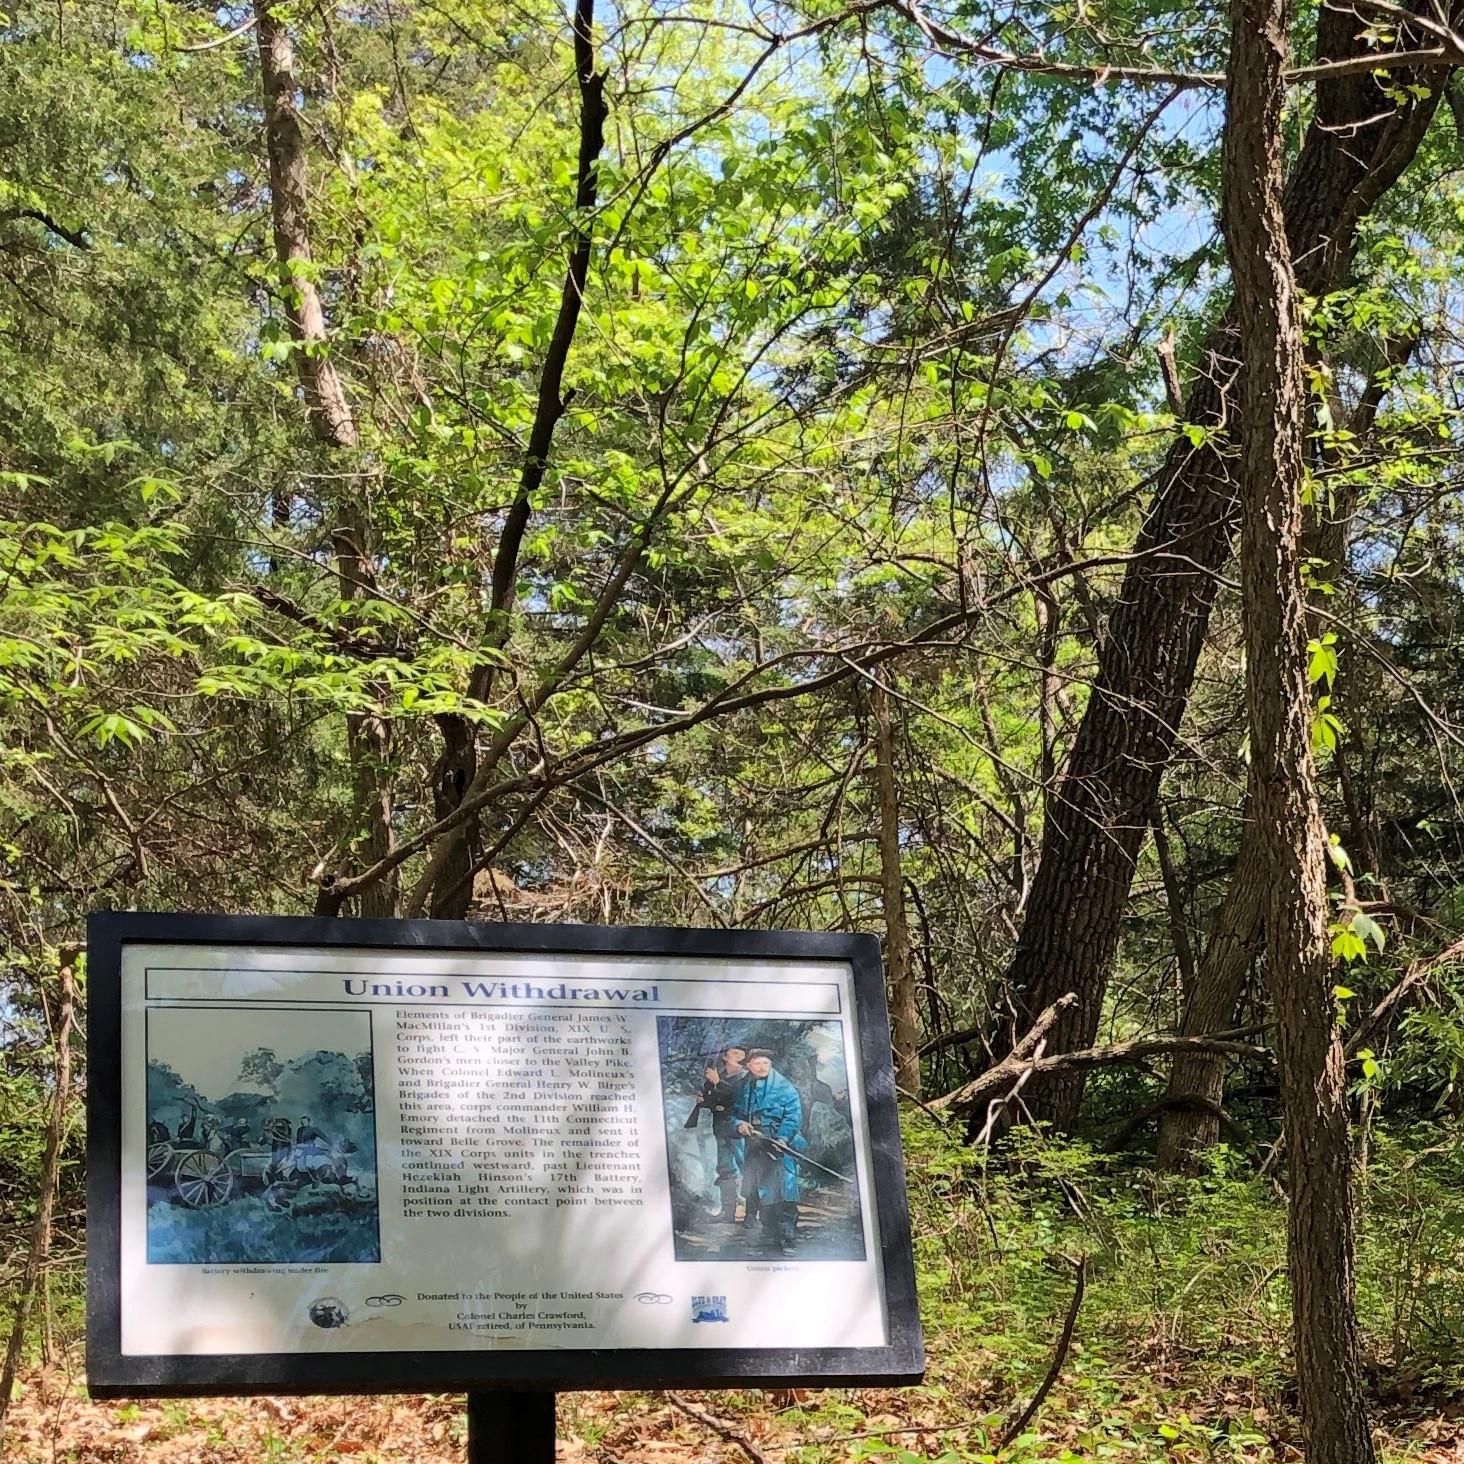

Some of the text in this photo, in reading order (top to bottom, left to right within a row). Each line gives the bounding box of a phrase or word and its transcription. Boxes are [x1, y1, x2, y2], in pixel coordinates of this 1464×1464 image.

[342, 978, 662, 1002] Union Withdrawal
[396, 1010, 450, 1019] Elements
[454, 1011, 465, 1020] of
[470, 1011, 524, 1023] Brigadier
[528, 1012, 572, 1021] General
[576, 1013, 612, 1023] James
[396, 1022, 470, 1031] MacMillan's
[480, 1023, 496, 1031] 1st
[506, 1023, 558, 1034] Division,
[568, 1024, 590, 1033] XIX
[440, 1033, 458, 1042] left
[464, 1034, 492, 1043] their
[498, 1034, 520, 1046] part
[526, 1035, 538, 1043] of
[542, 1035, 562, 1044] the
[566, 1035, 632, 1045] earthworks
[396, 1044, 410, 1052] to
[416, 1044, 446, 1055] fight
[492, 1045, 526, 1057] Major
[532, 1046, 578, 1055] General
[586, 1047, 614, 1057] John
[398, 1055, 452, 1065] Gordon's
[486, 1057, 520, 1066] closer
[524, 1057, 537, 1066] to
[542, 1058, 561, 1066] the
[564, 1058, 600, 1070] Valley
[606, 1059, 633, 1068] Pike.
[398, 1067, 434, 1076] When
[442, 1067, 489, 1077] Colonel
[498, 1068, 543, 1077] Edward
[569, 1069, 635, 1079] Molineux's
[398, 1078, 422, 1087] and
[428, 1079, 481, 1090] Brigadier
[486, 1079, 532, 1088] General
[536, 1080, 572, 1091] Henry
[598, 1081, 636, 1092] Birge's
[399, 1090, 636, 1102] Brigades of the 2nd Division reached
[400, 1102, 422, 1110] this
[460, 1104, 492, 1114] corps
[496, 1103, 568, 1112] commander
[572, 1104, 618, 1113] William
[400, 1113, 638, 1125] Emory detached the 11th Connecticut
[400, 1125, 639, 1137] Regiment from Molineux and sent it
[400, 1137, 640, 1147] toward Belle Grove. The remainder of
[401, 1149, 640, 1161] the XIX Corps units in the trenches
[401, 1161, 465, 1170] continued
[543, 1162, 568, 1173] past
[576, 1162, 640, 1170] Lieutenant
[402, 1173, 462, 1181] Hezekiah
[478, 1173, 532, 1181] Hinson's
[550, 1173, 577, 1182] 17th
[402, 1185, 450, 1193] Indiana
[458, 1185, 489, 1196] Light
[496, 1185, 550, 1196] Artillery,
[557, 1185, 594, 1194] which
[631, 1185, 642, 1194] in
[402, 1197, 643, 1208] position at the contact point between
[403, 1209, 512, 1217] the two divisions.
[416, 1291, 624, 1302] Donated to the People of the United States
[514, 1302, 528, 1311] by
[456, 1311, 586, 1321] Colonel Charles Crawford,
[514, 1321, 526, 1329] of
[528, 1321, 598, 1331] Pennsylvania.
